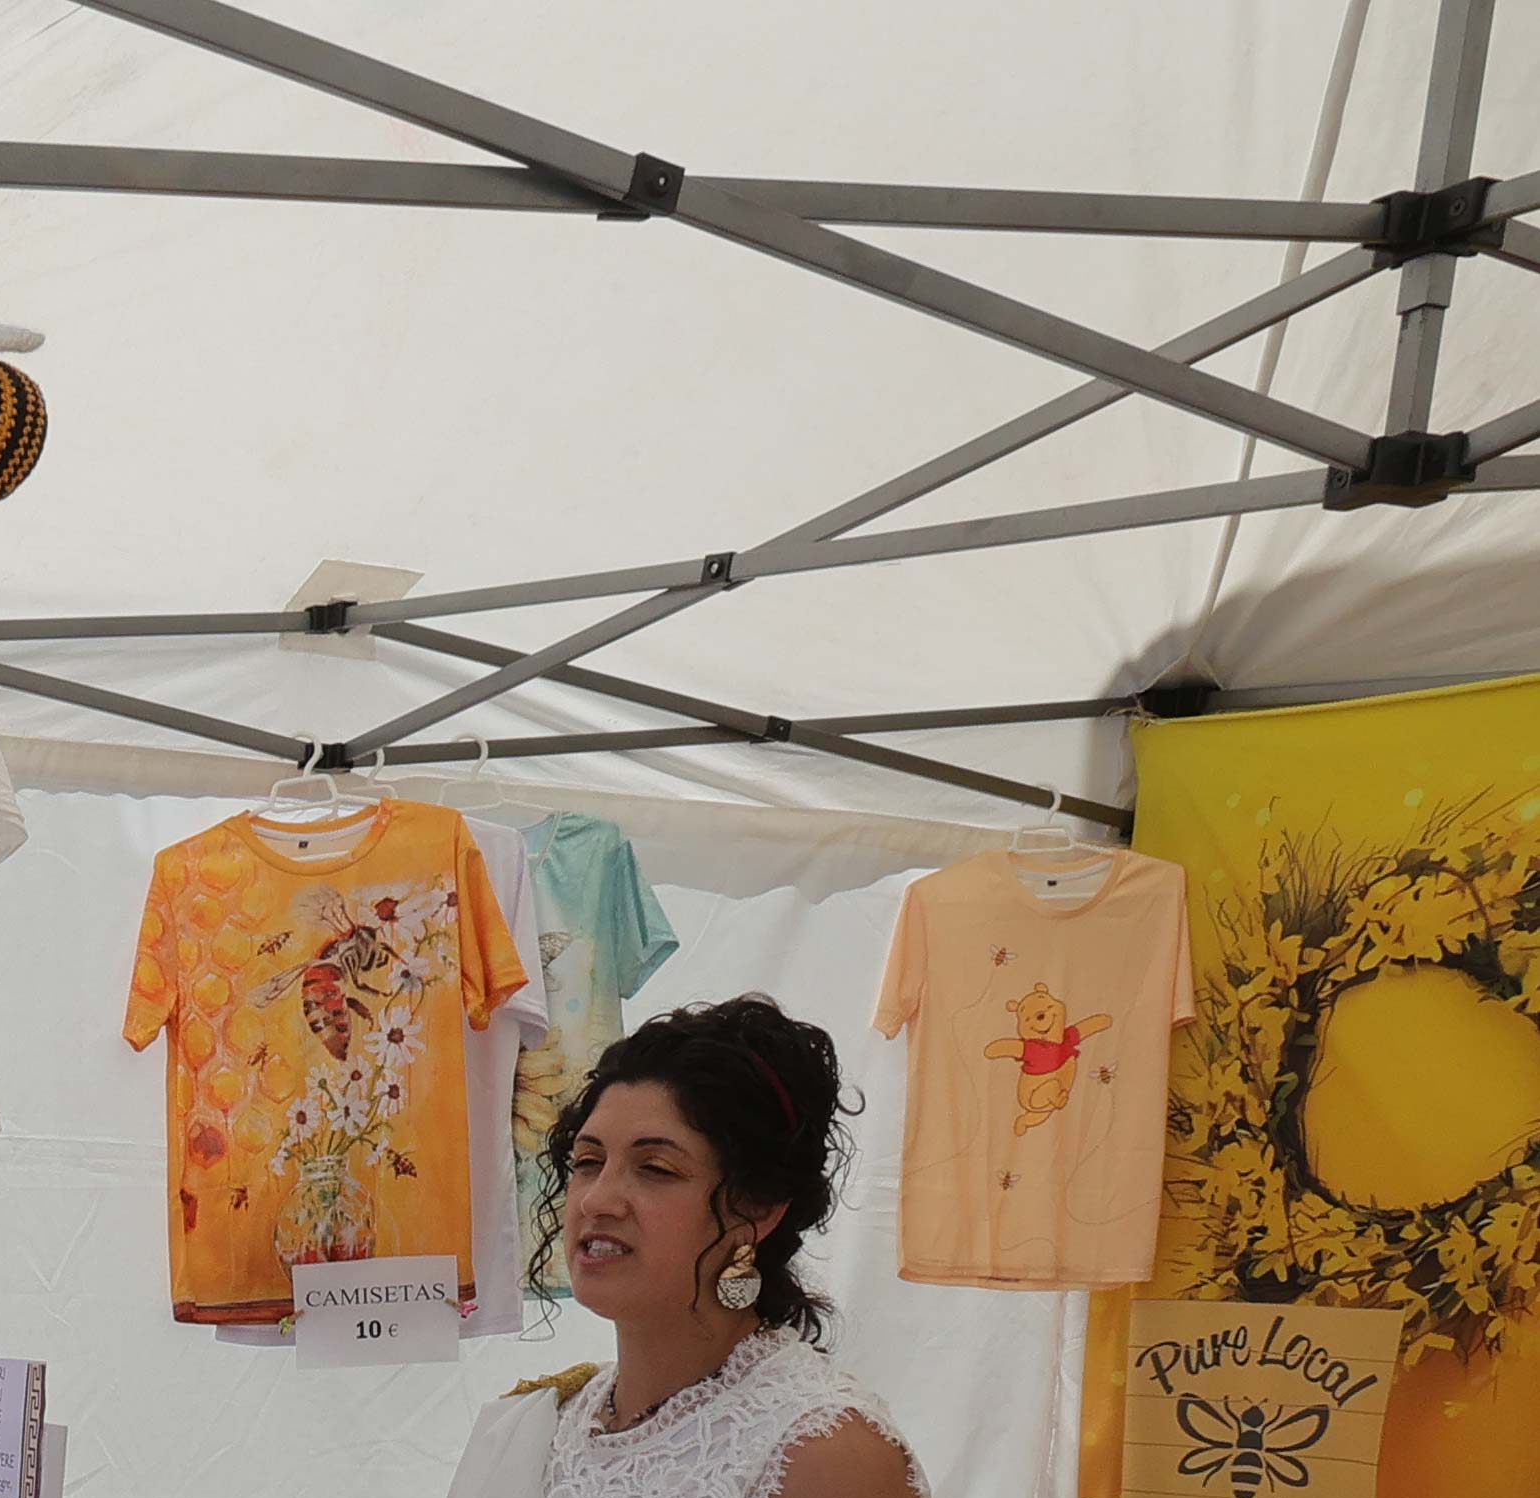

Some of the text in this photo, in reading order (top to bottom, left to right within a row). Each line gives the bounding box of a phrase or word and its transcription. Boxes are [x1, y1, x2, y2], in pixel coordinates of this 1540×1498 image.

[304, 1281, 446, 1308] CAMISETAS
[355, 1318, 399, 1340] 10 €
[1134, 1316, 1378, 1408] Pure Local
